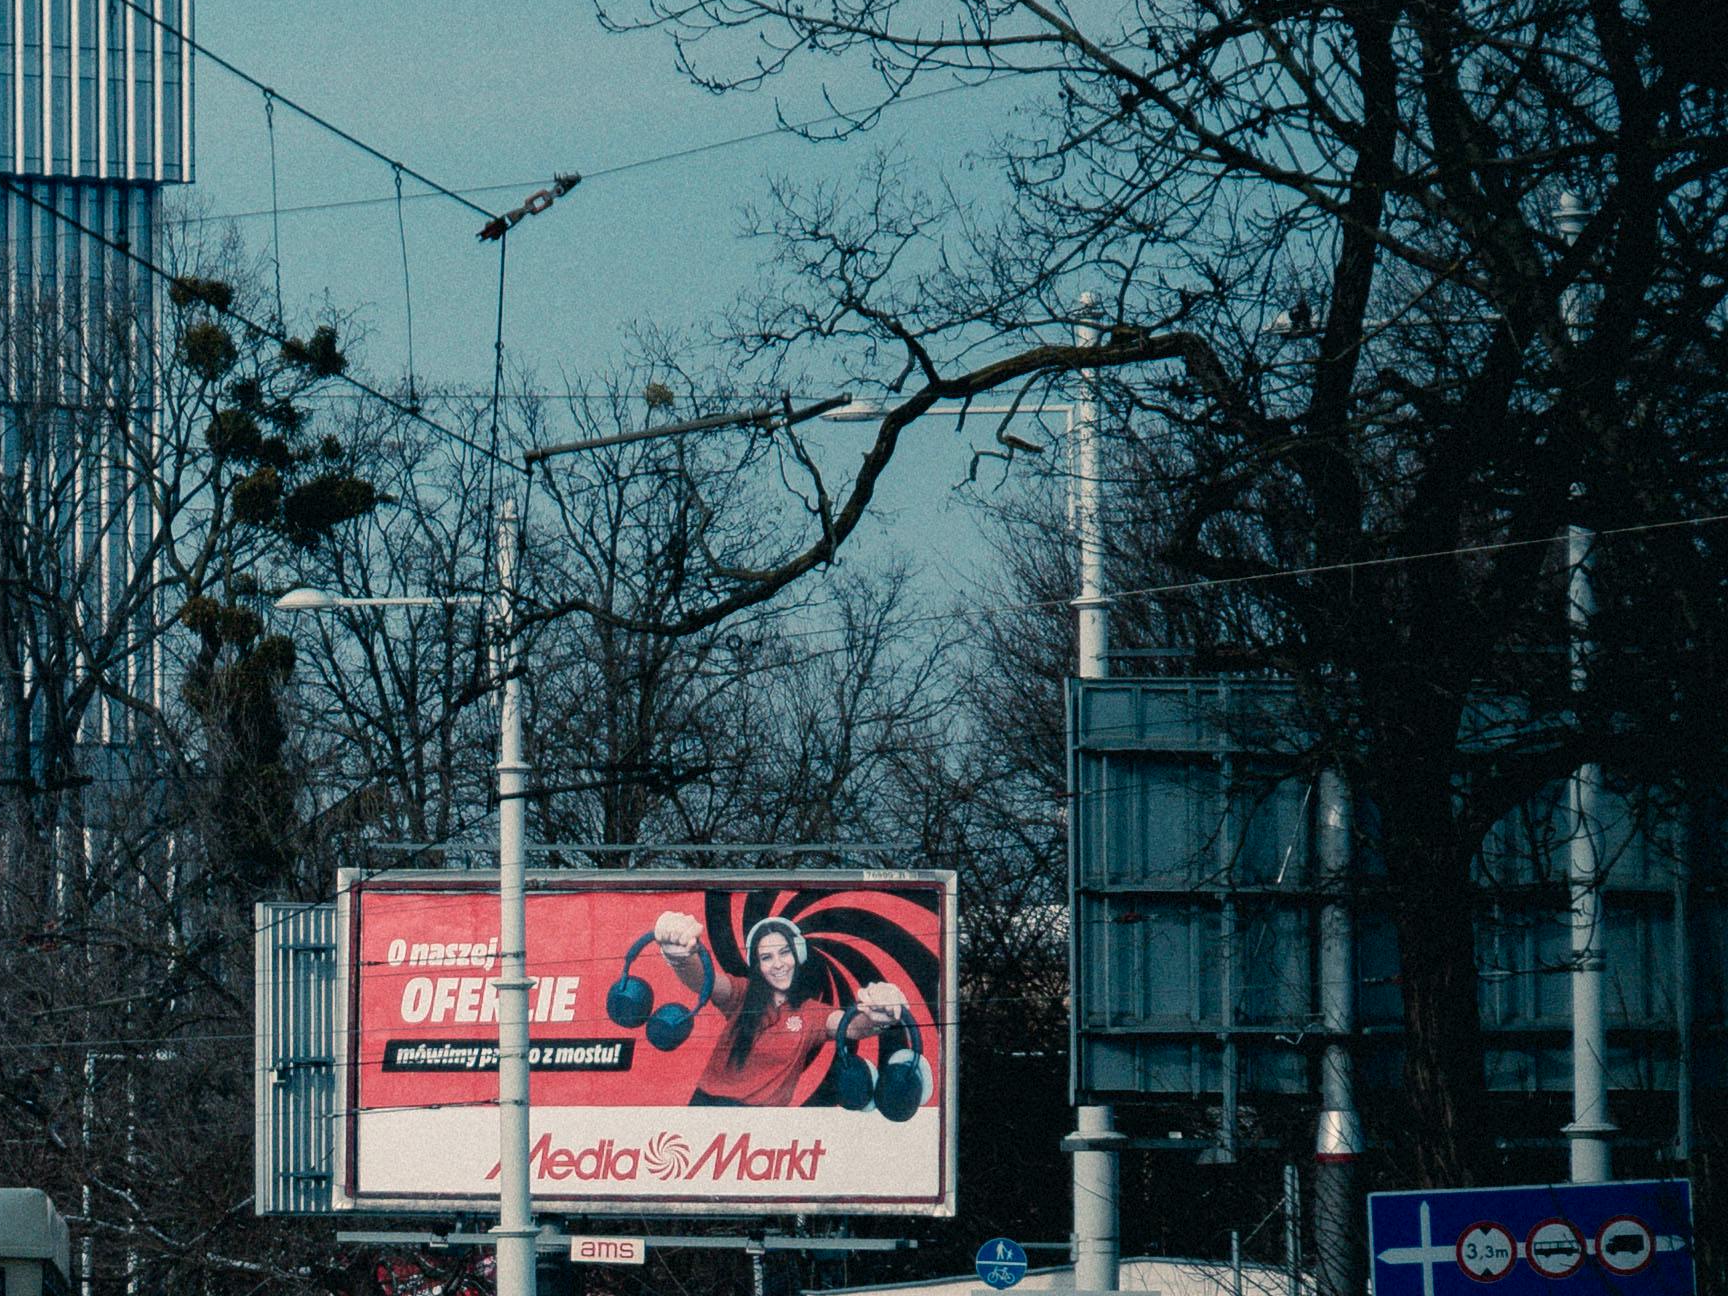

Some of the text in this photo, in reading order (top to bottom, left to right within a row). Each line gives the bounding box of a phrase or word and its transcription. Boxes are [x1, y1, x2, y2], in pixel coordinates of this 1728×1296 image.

[387, 936, 499, 972] O naszej
[542, 1047, 554, 1065] z
[554, 1042, 623, 1065] mostu!
[683, 1132, 827, 1181] Markt
[579, 1239, 635, 1260] ams
